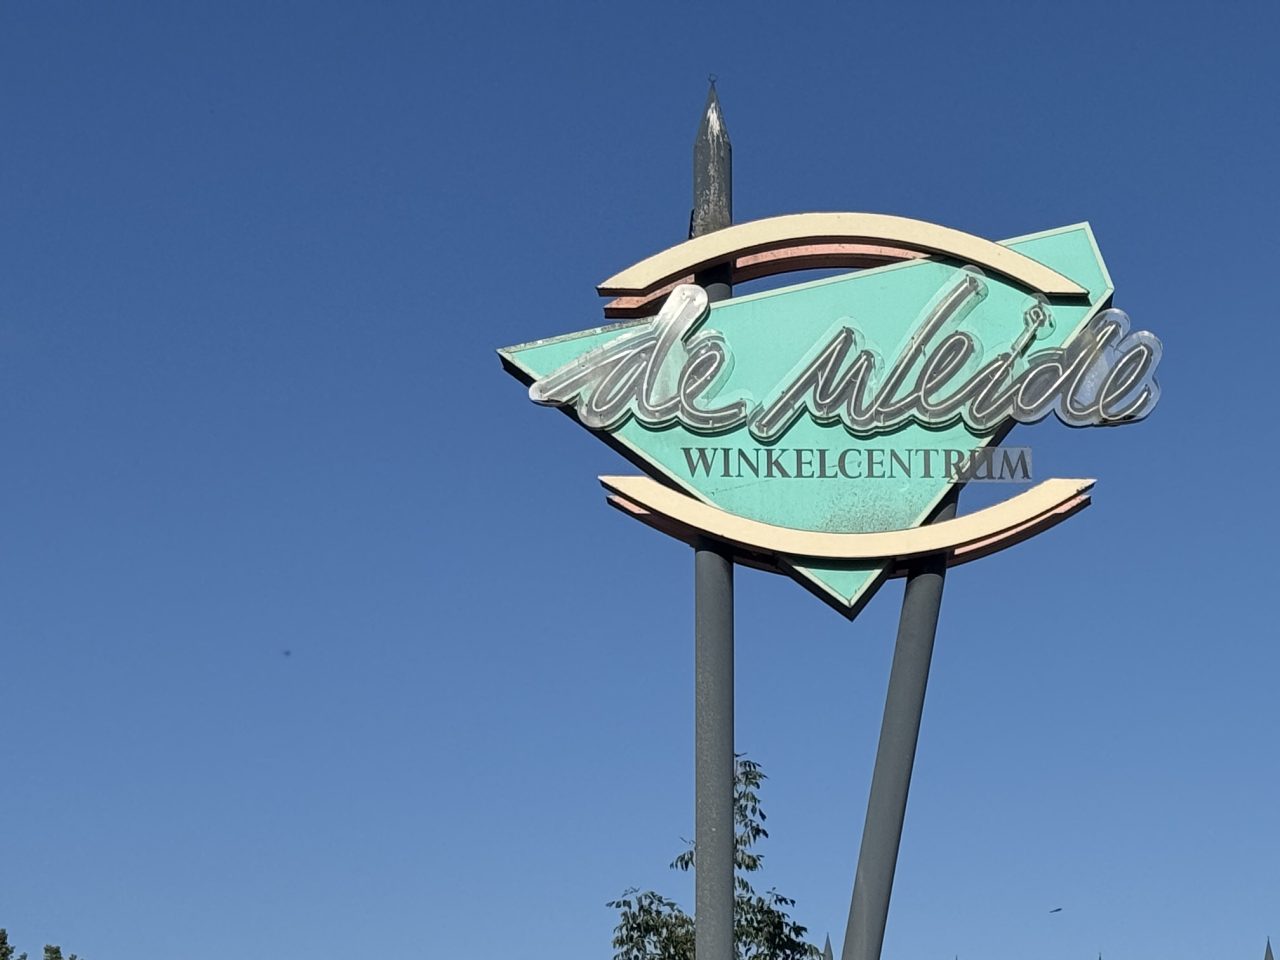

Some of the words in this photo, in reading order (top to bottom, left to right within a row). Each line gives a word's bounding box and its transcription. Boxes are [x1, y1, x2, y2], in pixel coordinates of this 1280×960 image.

[530, 284, 746, 428] de
[748, 266, 1162, 441] Weide
[681, 445, 1031, 482] WINKELCENTRUM
